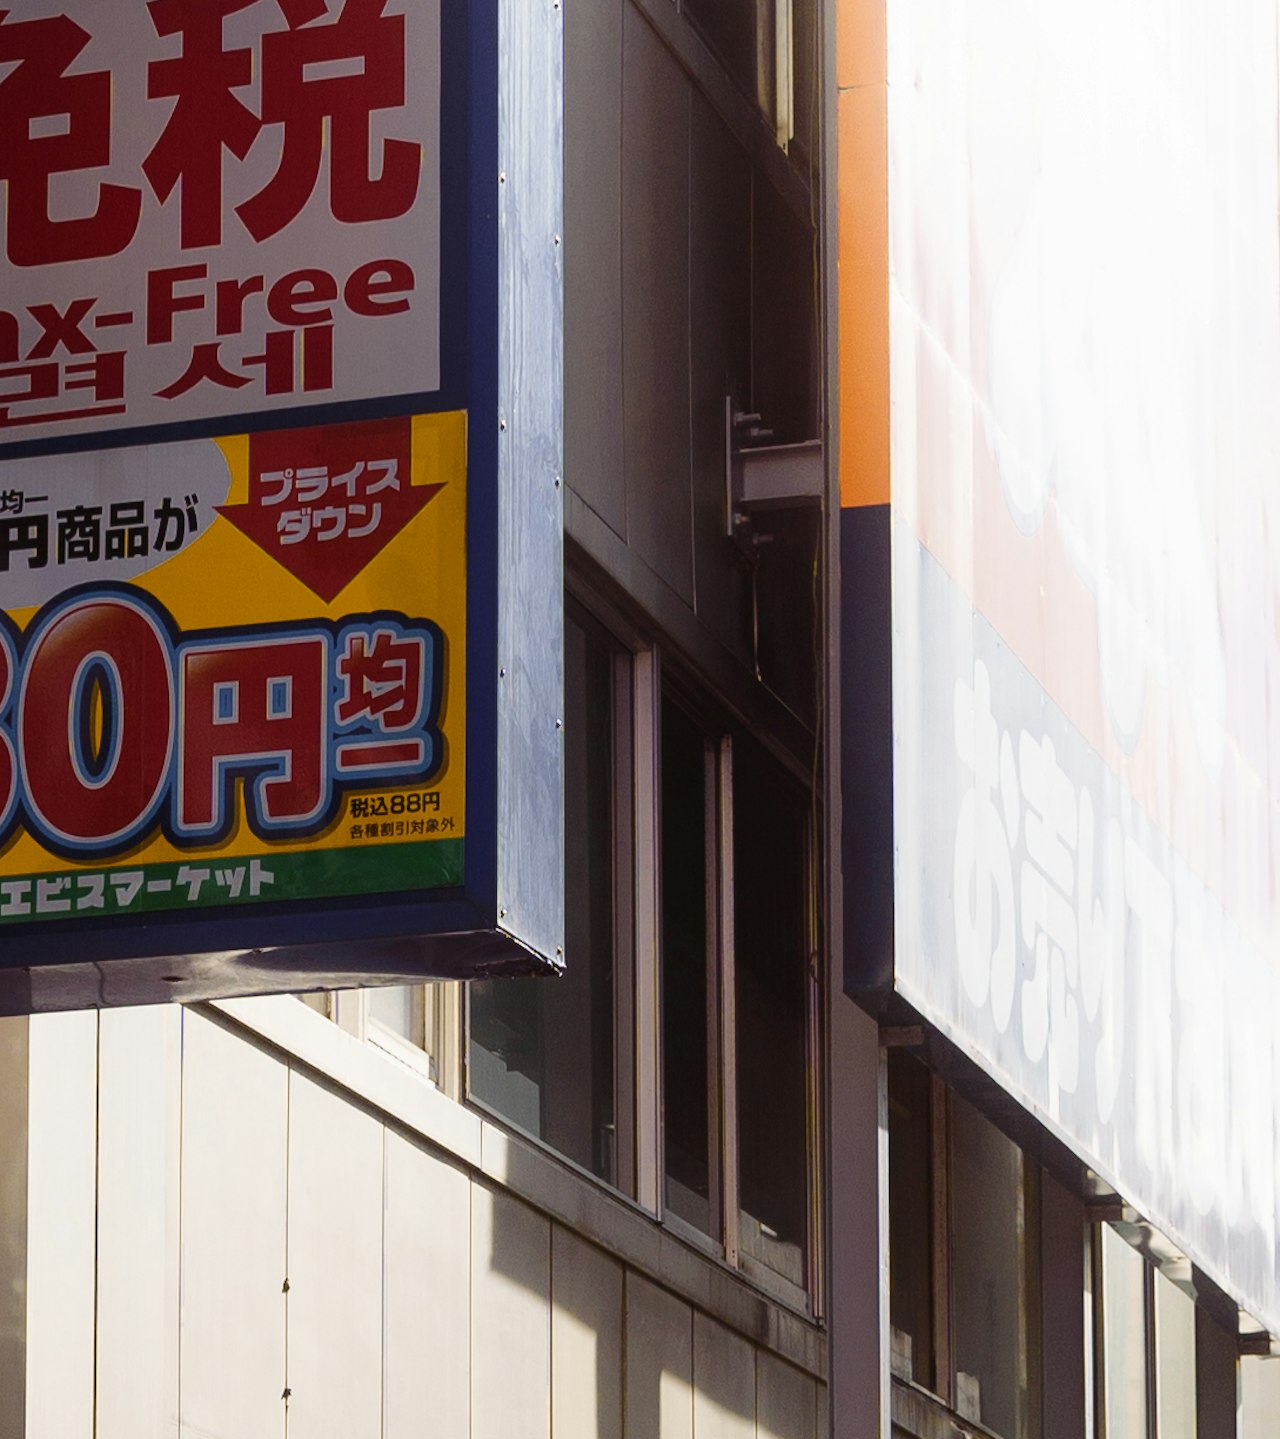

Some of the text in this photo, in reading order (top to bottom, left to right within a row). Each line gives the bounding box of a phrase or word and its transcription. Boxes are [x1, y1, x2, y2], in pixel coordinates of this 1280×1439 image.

[260, 458, 400, 505] プライス
[276, 502, 383, 546] ダウン
[350, 792, 440, 818] 税込88円
[350, 817, 455, 839] 各種割引対象外
[0, 858, 275, 916] エビスマーケット
